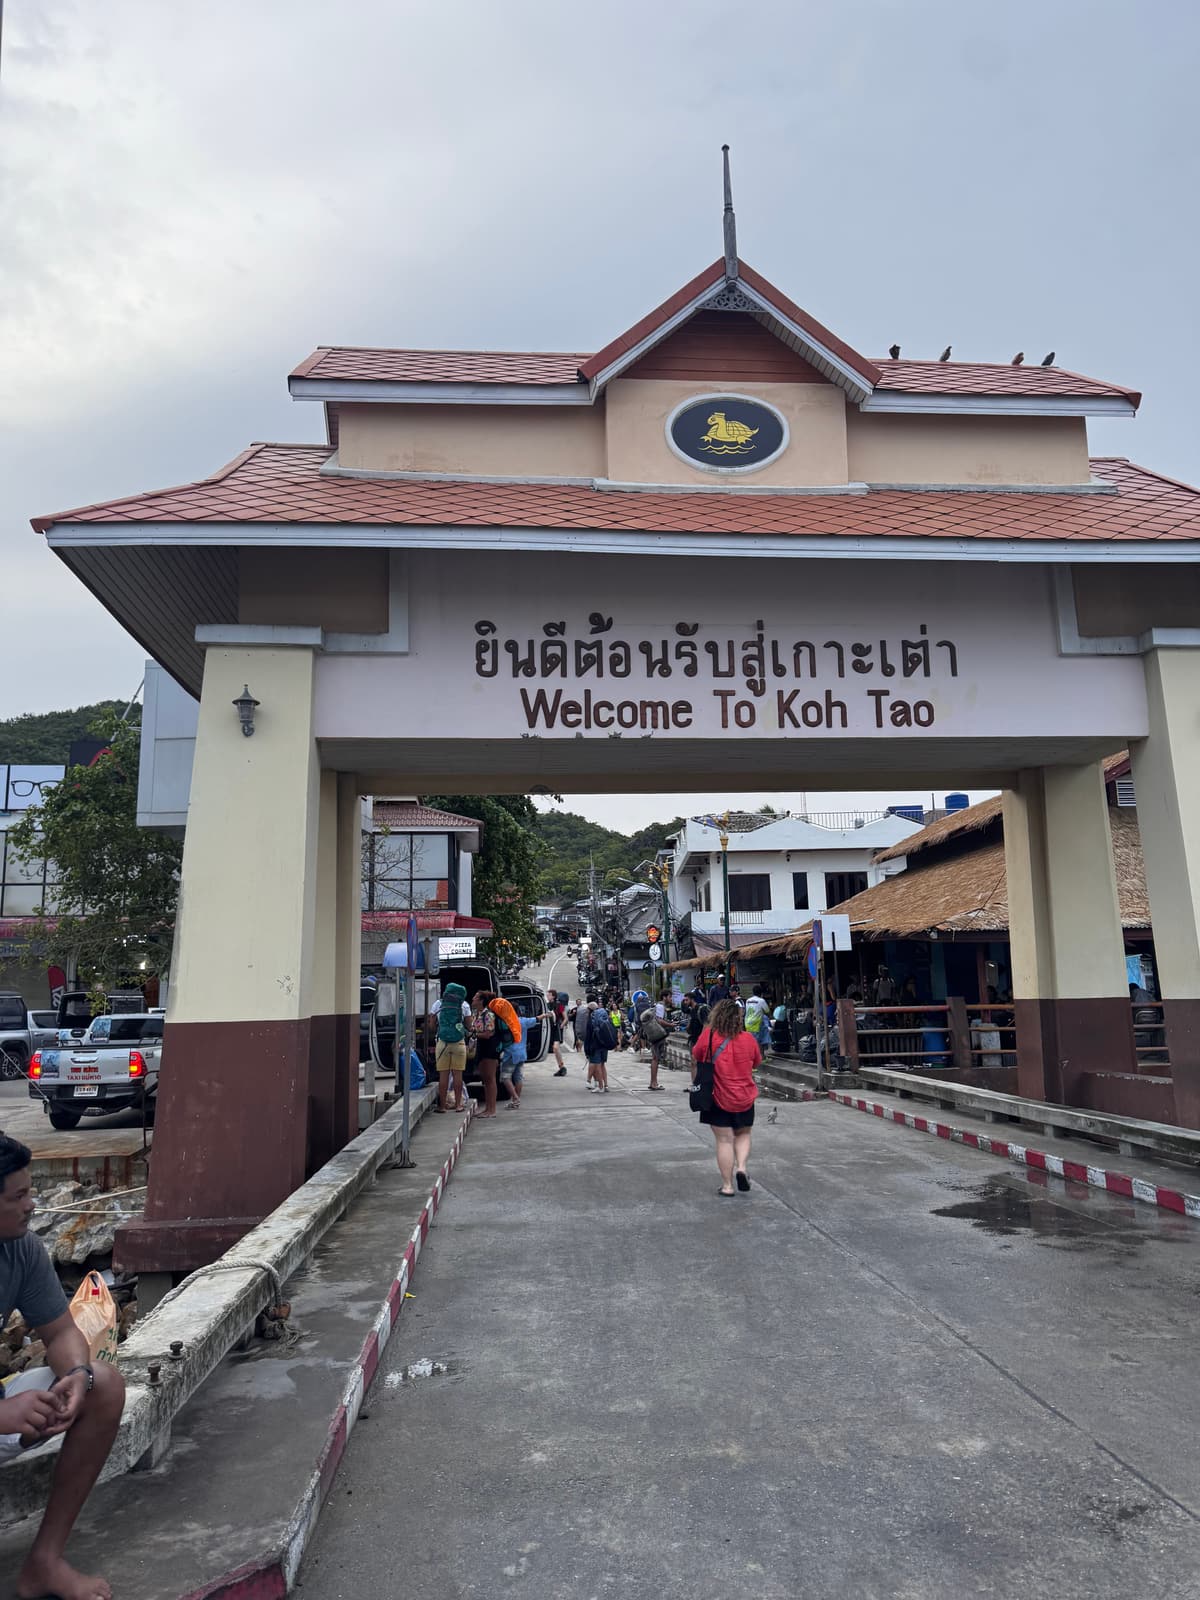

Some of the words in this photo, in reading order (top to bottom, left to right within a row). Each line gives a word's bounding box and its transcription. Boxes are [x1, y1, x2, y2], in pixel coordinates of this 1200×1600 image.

[474, 612, 958, 697] ยินดีต้อนรับสู่เกาะเต่า
[520, 688, 693, 729] Welcome
[713, 689, 756, 729] To
[777, 689, 847, 729] Koh
[867, 689, 935, 729] Tao
